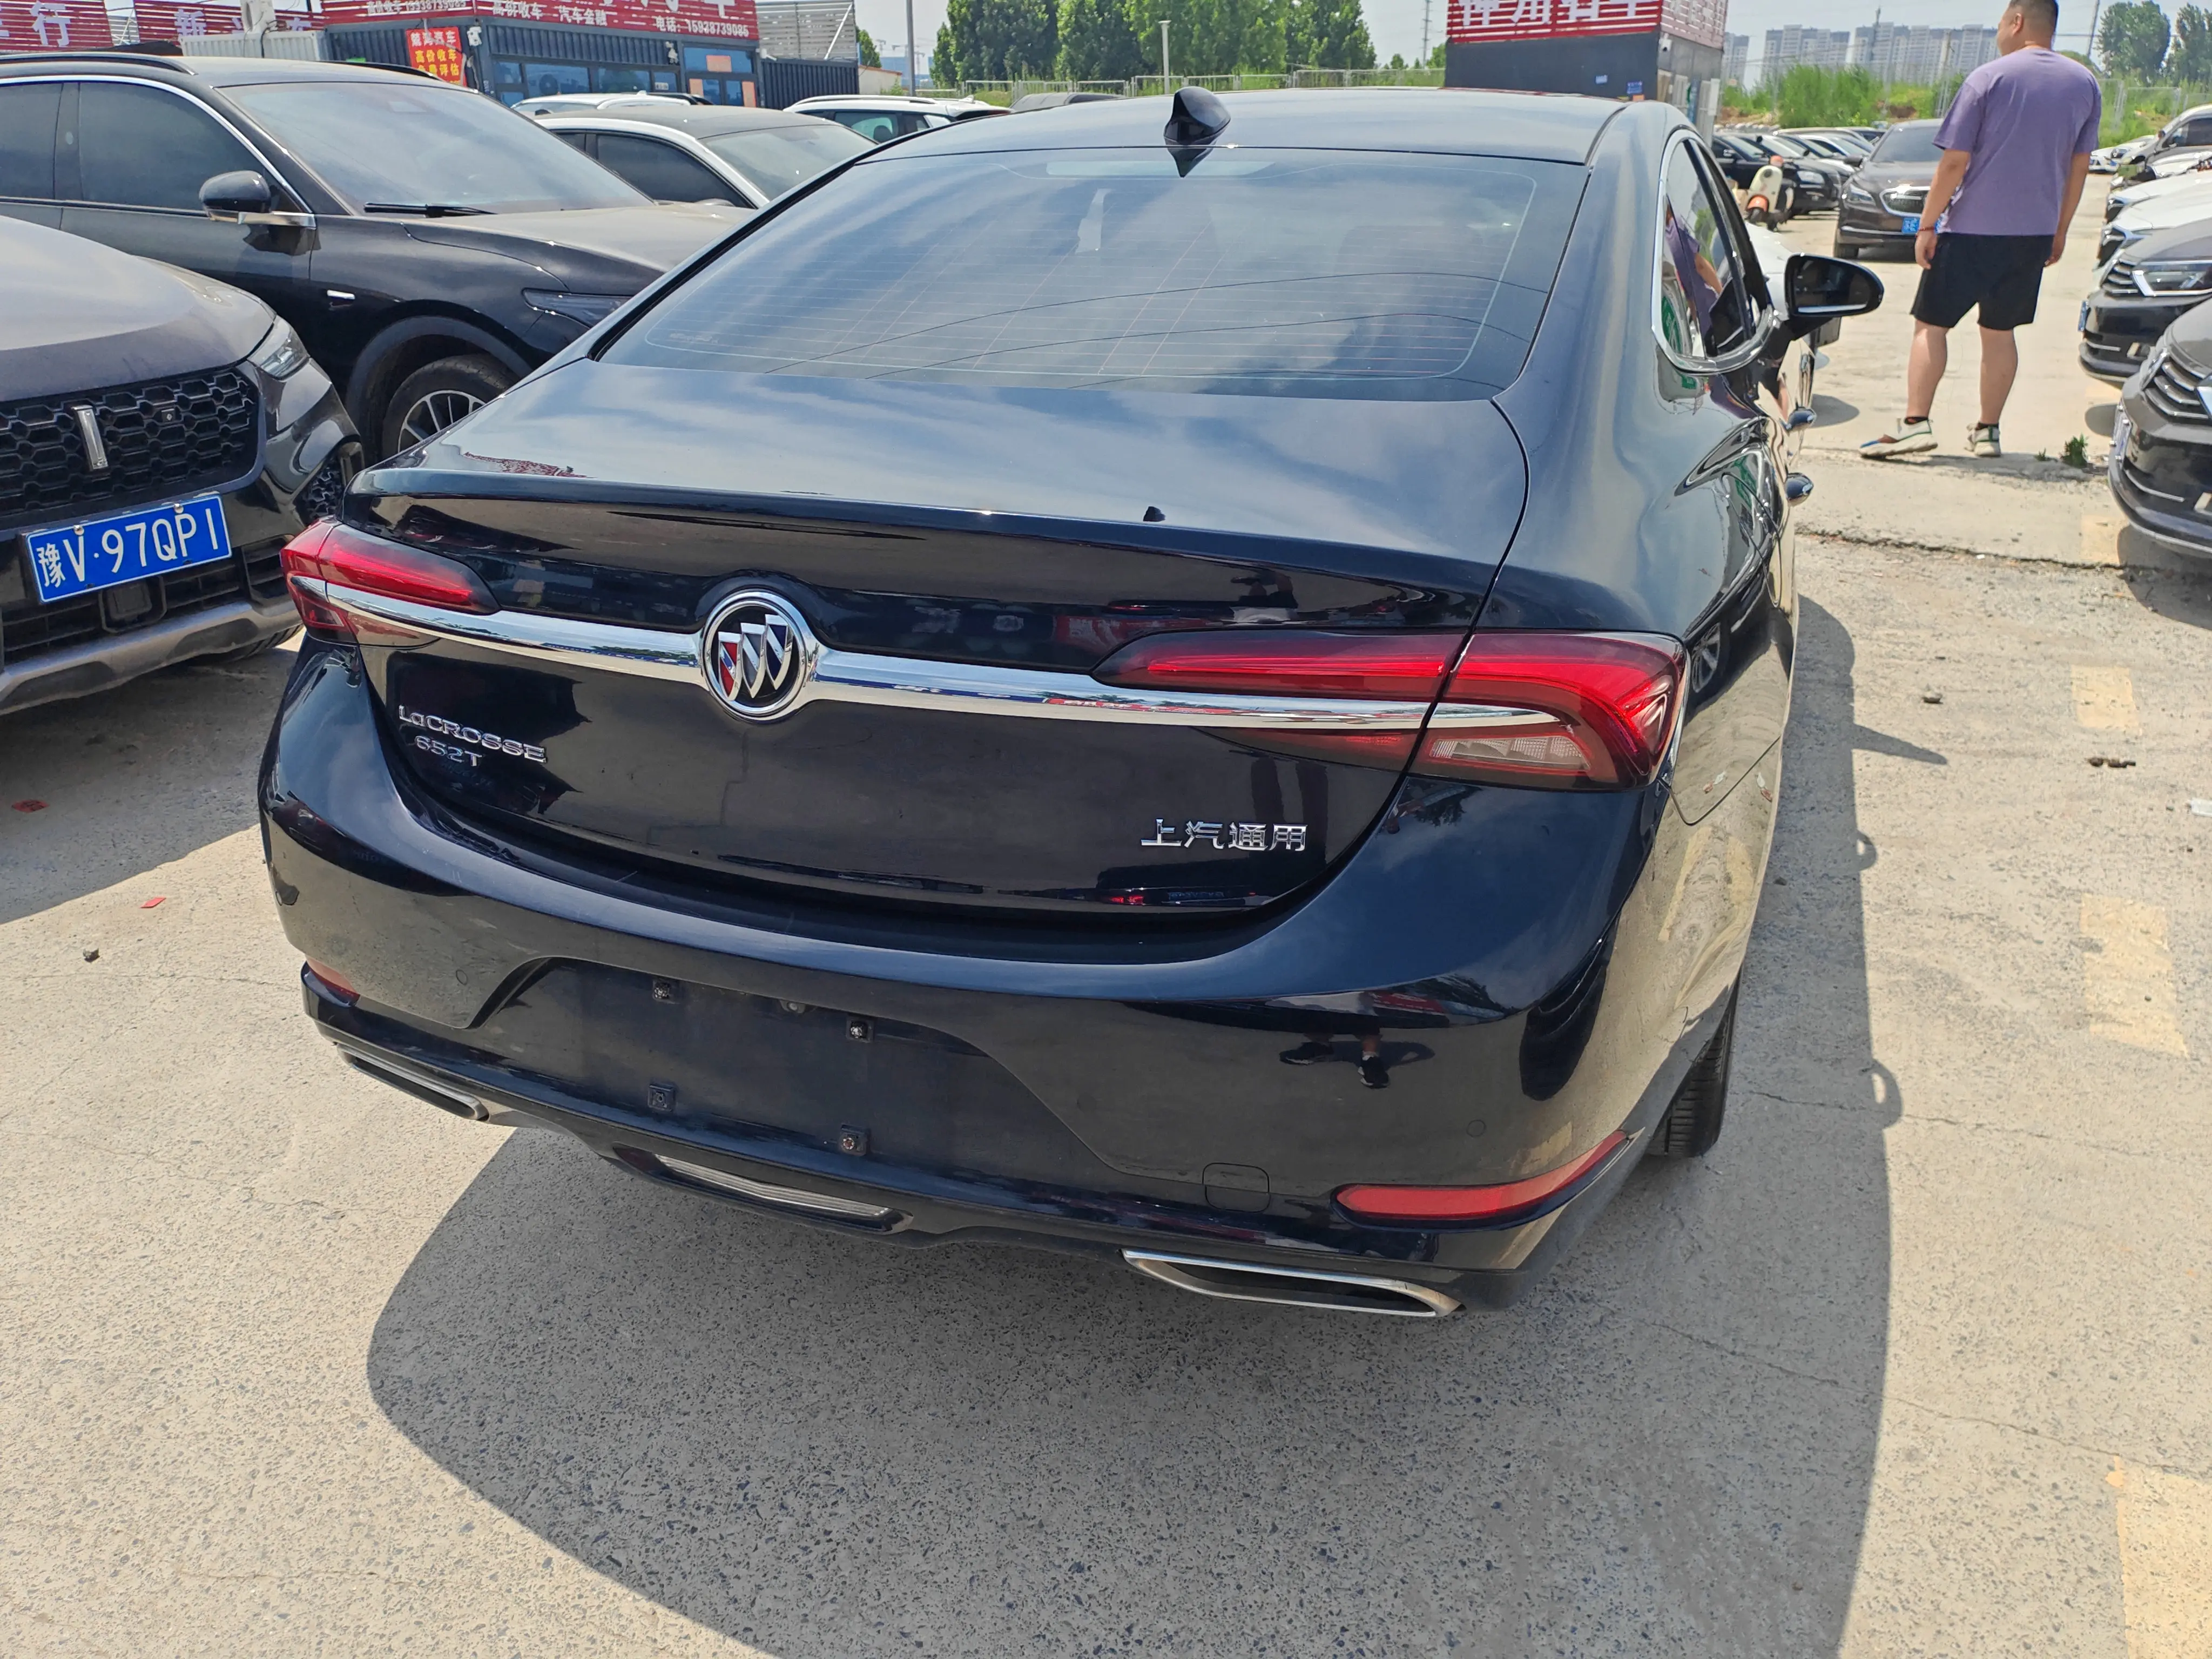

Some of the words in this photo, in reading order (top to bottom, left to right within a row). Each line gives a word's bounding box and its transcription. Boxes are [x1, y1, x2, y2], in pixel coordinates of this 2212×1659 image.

[492, 1, 543, 21] 高价收车
[558, 5, 608, 26] 汽车金融
[399, 704, 547, 763] LaCROSSE
[414, 735, 482, 767] 652T
[1141, 818, 1309, 852] 上汽通用
